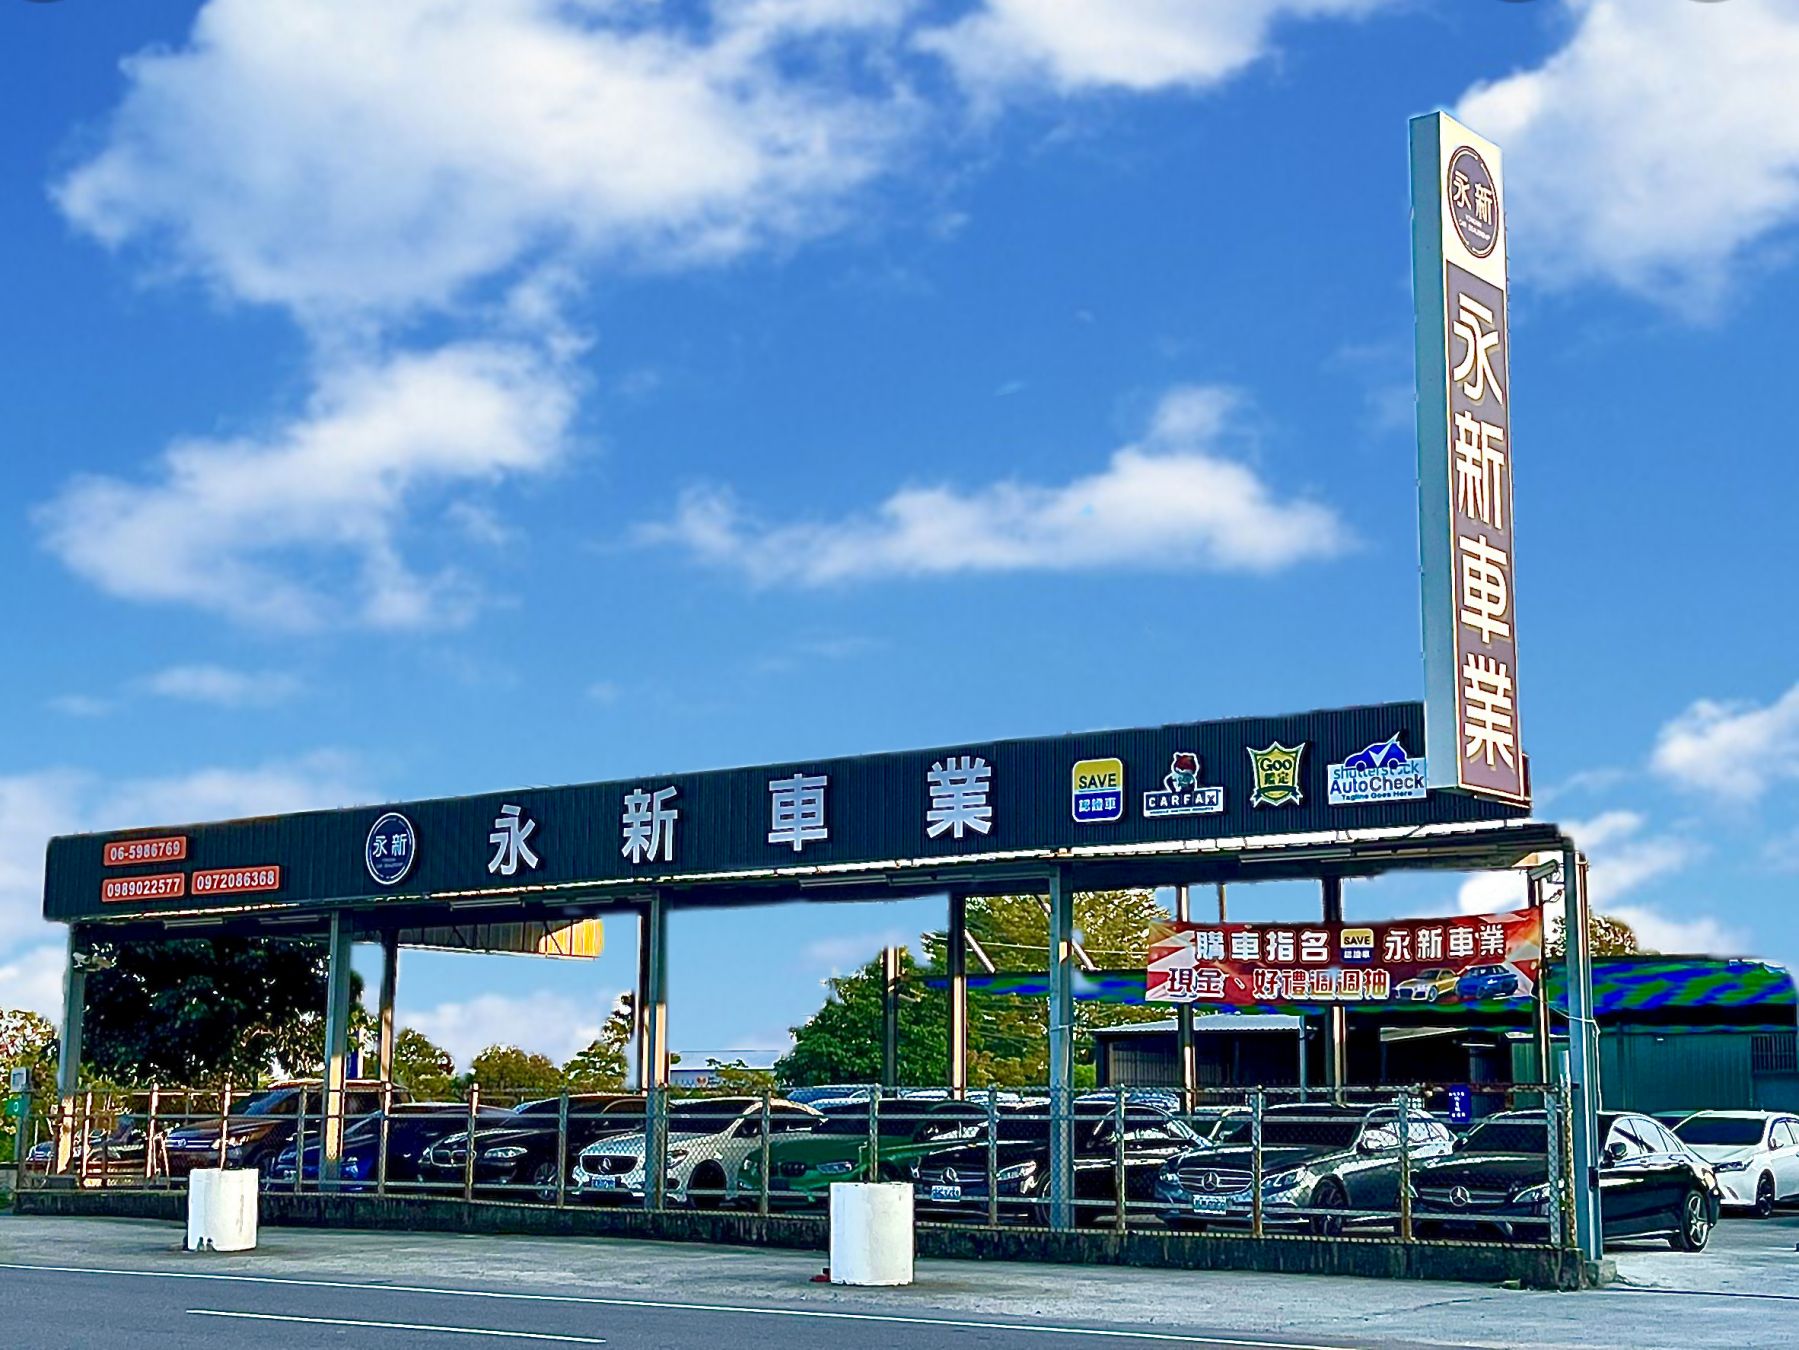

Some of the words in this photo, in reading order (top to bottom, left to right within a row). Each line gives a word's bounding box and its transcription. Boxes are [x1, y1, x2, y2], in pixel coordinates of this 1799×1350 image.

[1452, 170, 1493, 226] 永新
[1452, 291, 1514, 770] 永新車業
[1078, 773, 1117, 790] SAVE
[1330, 774, 1425, 795] AutoCheck
[1148, 792, 1217, 808] CARFAX
[488, 755, 993, 875] 永新車業
[110, 840, 181, 861] 06-5986769
[372, 833, 408, 858] 永新
[107, 877, 181, 898] 0989022577
[196, 870, 275, 890] 0972086368
[1196, 930, 1329, 962] 購車指名
[1343, 935, 1371, 945] SAVE
[1384, 924, 1505, 961] 永新車業
